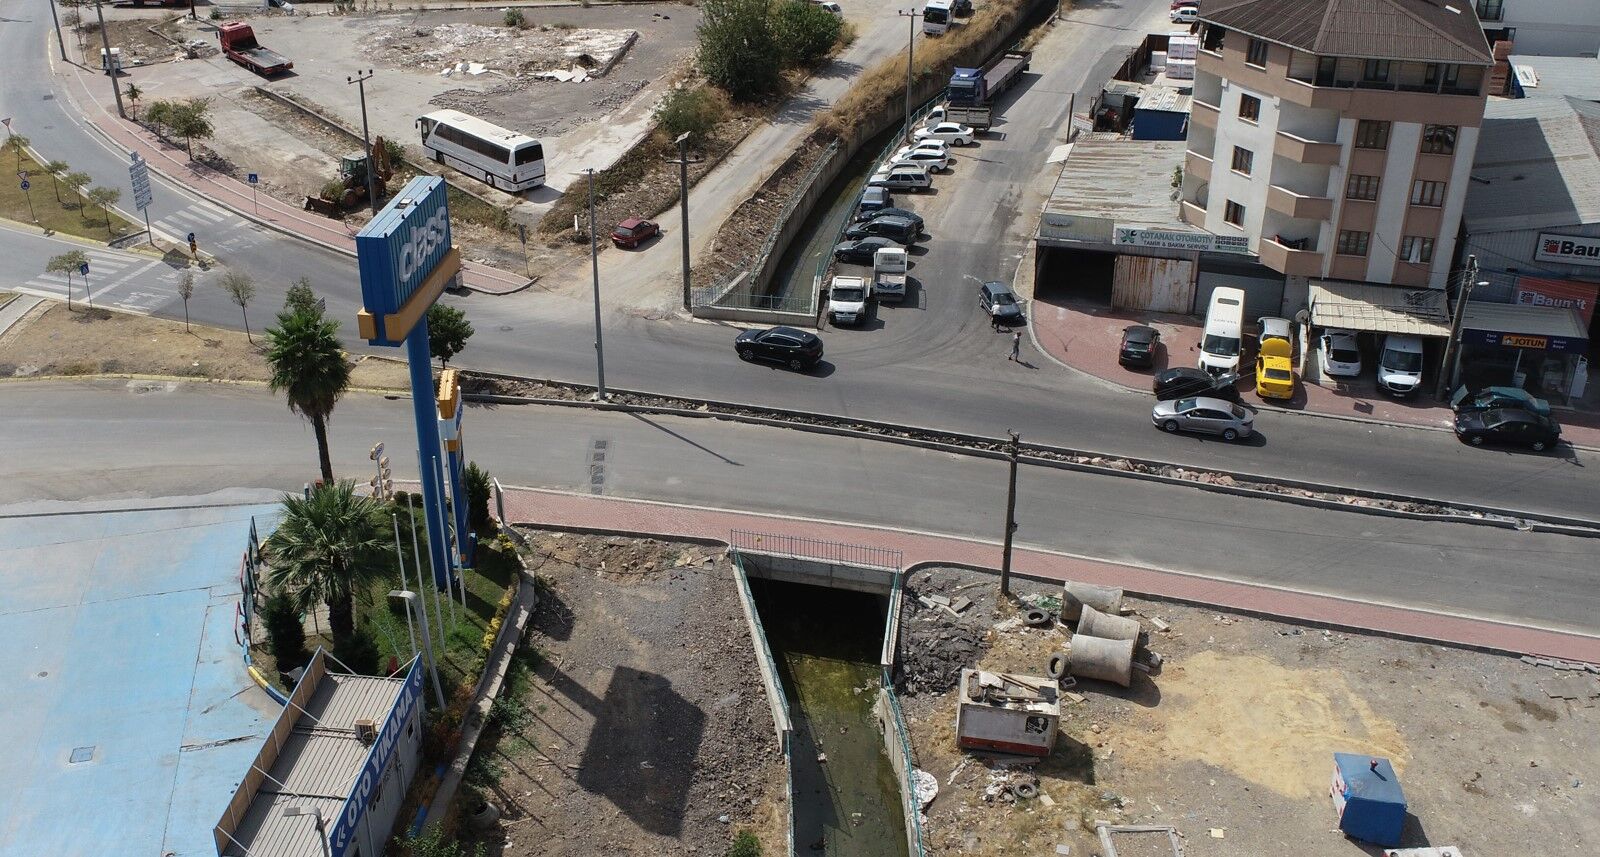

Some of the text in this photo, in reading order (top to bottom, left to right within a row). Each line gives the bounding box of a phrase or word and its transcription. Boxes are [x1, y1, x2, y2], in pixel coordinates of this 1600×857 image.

[399, 206, 447, 282] class
[1514, 337, 1545, 348] JOTUN
[347, 687, 413, 828] OTO YIKAMA
